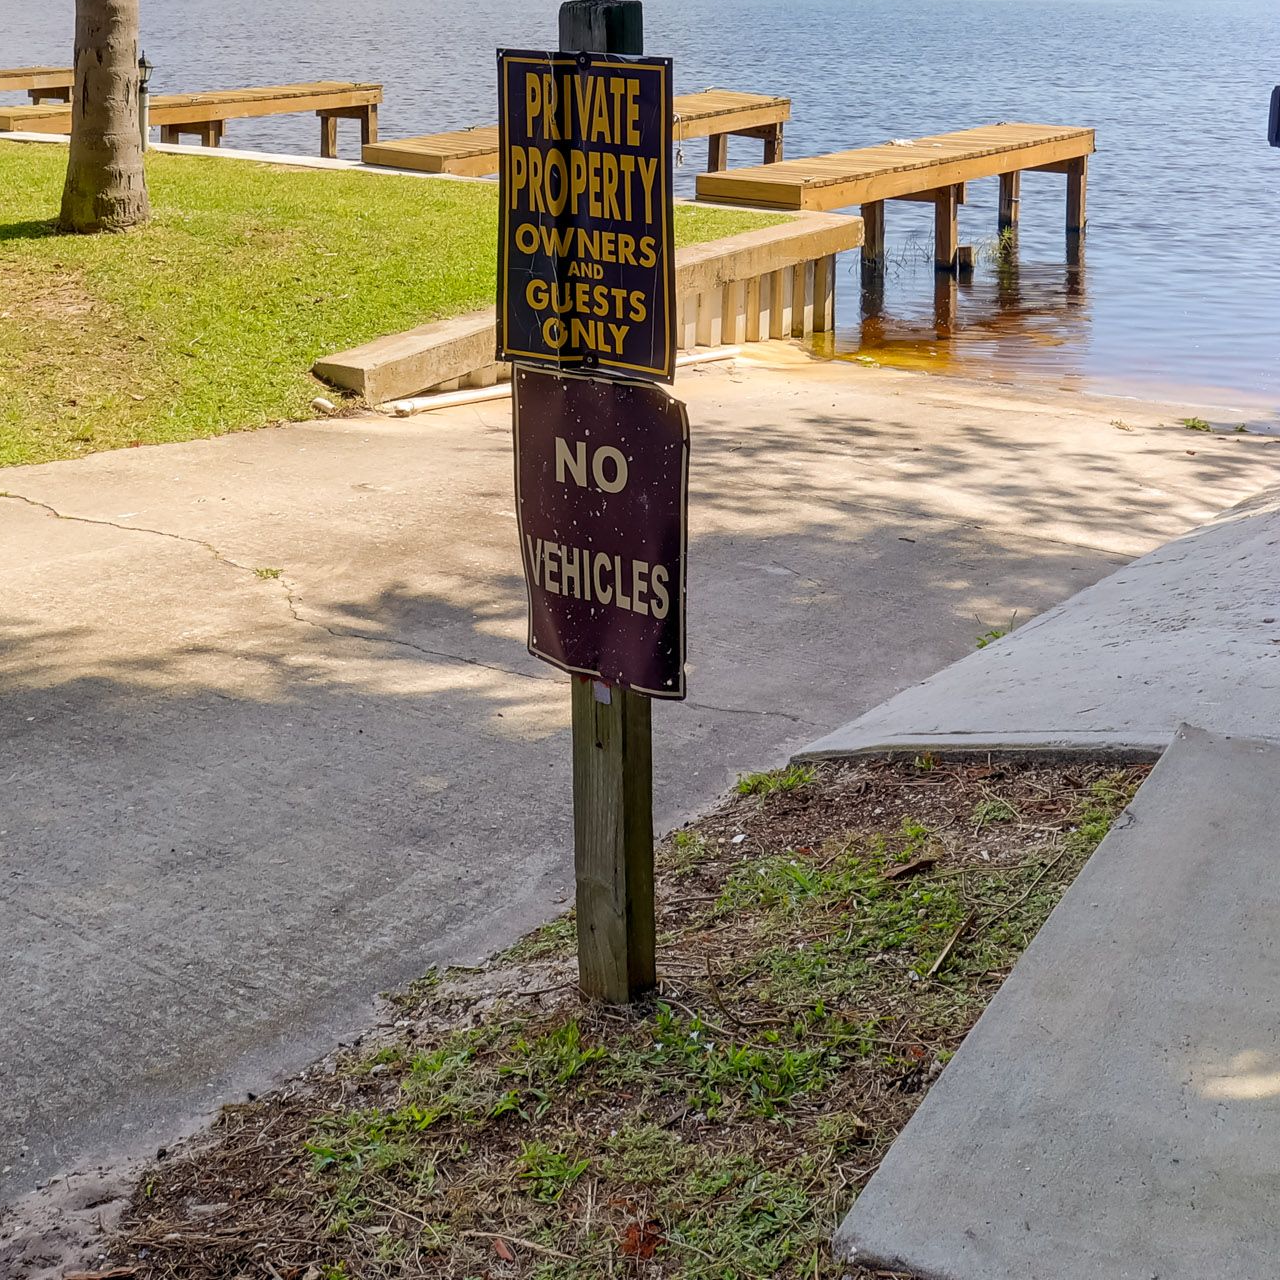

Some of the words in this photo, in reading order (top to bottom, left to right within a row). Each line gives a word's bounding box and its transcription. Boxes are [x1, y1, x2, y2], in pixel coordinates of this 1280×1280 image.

[525, 71, 641, 147] PRIVATE
[511, 144, 658, 224] PROPERTY
[515, 222, 657, 269] OWNERS
[567, 260, 604, 280] AND
[525, 278, 647, 322] GUESTS
[542, 317, 631, 355] ONLY
[555, 436, 629, 494] NO
[526, 534, 670, 620] VEHICLES
